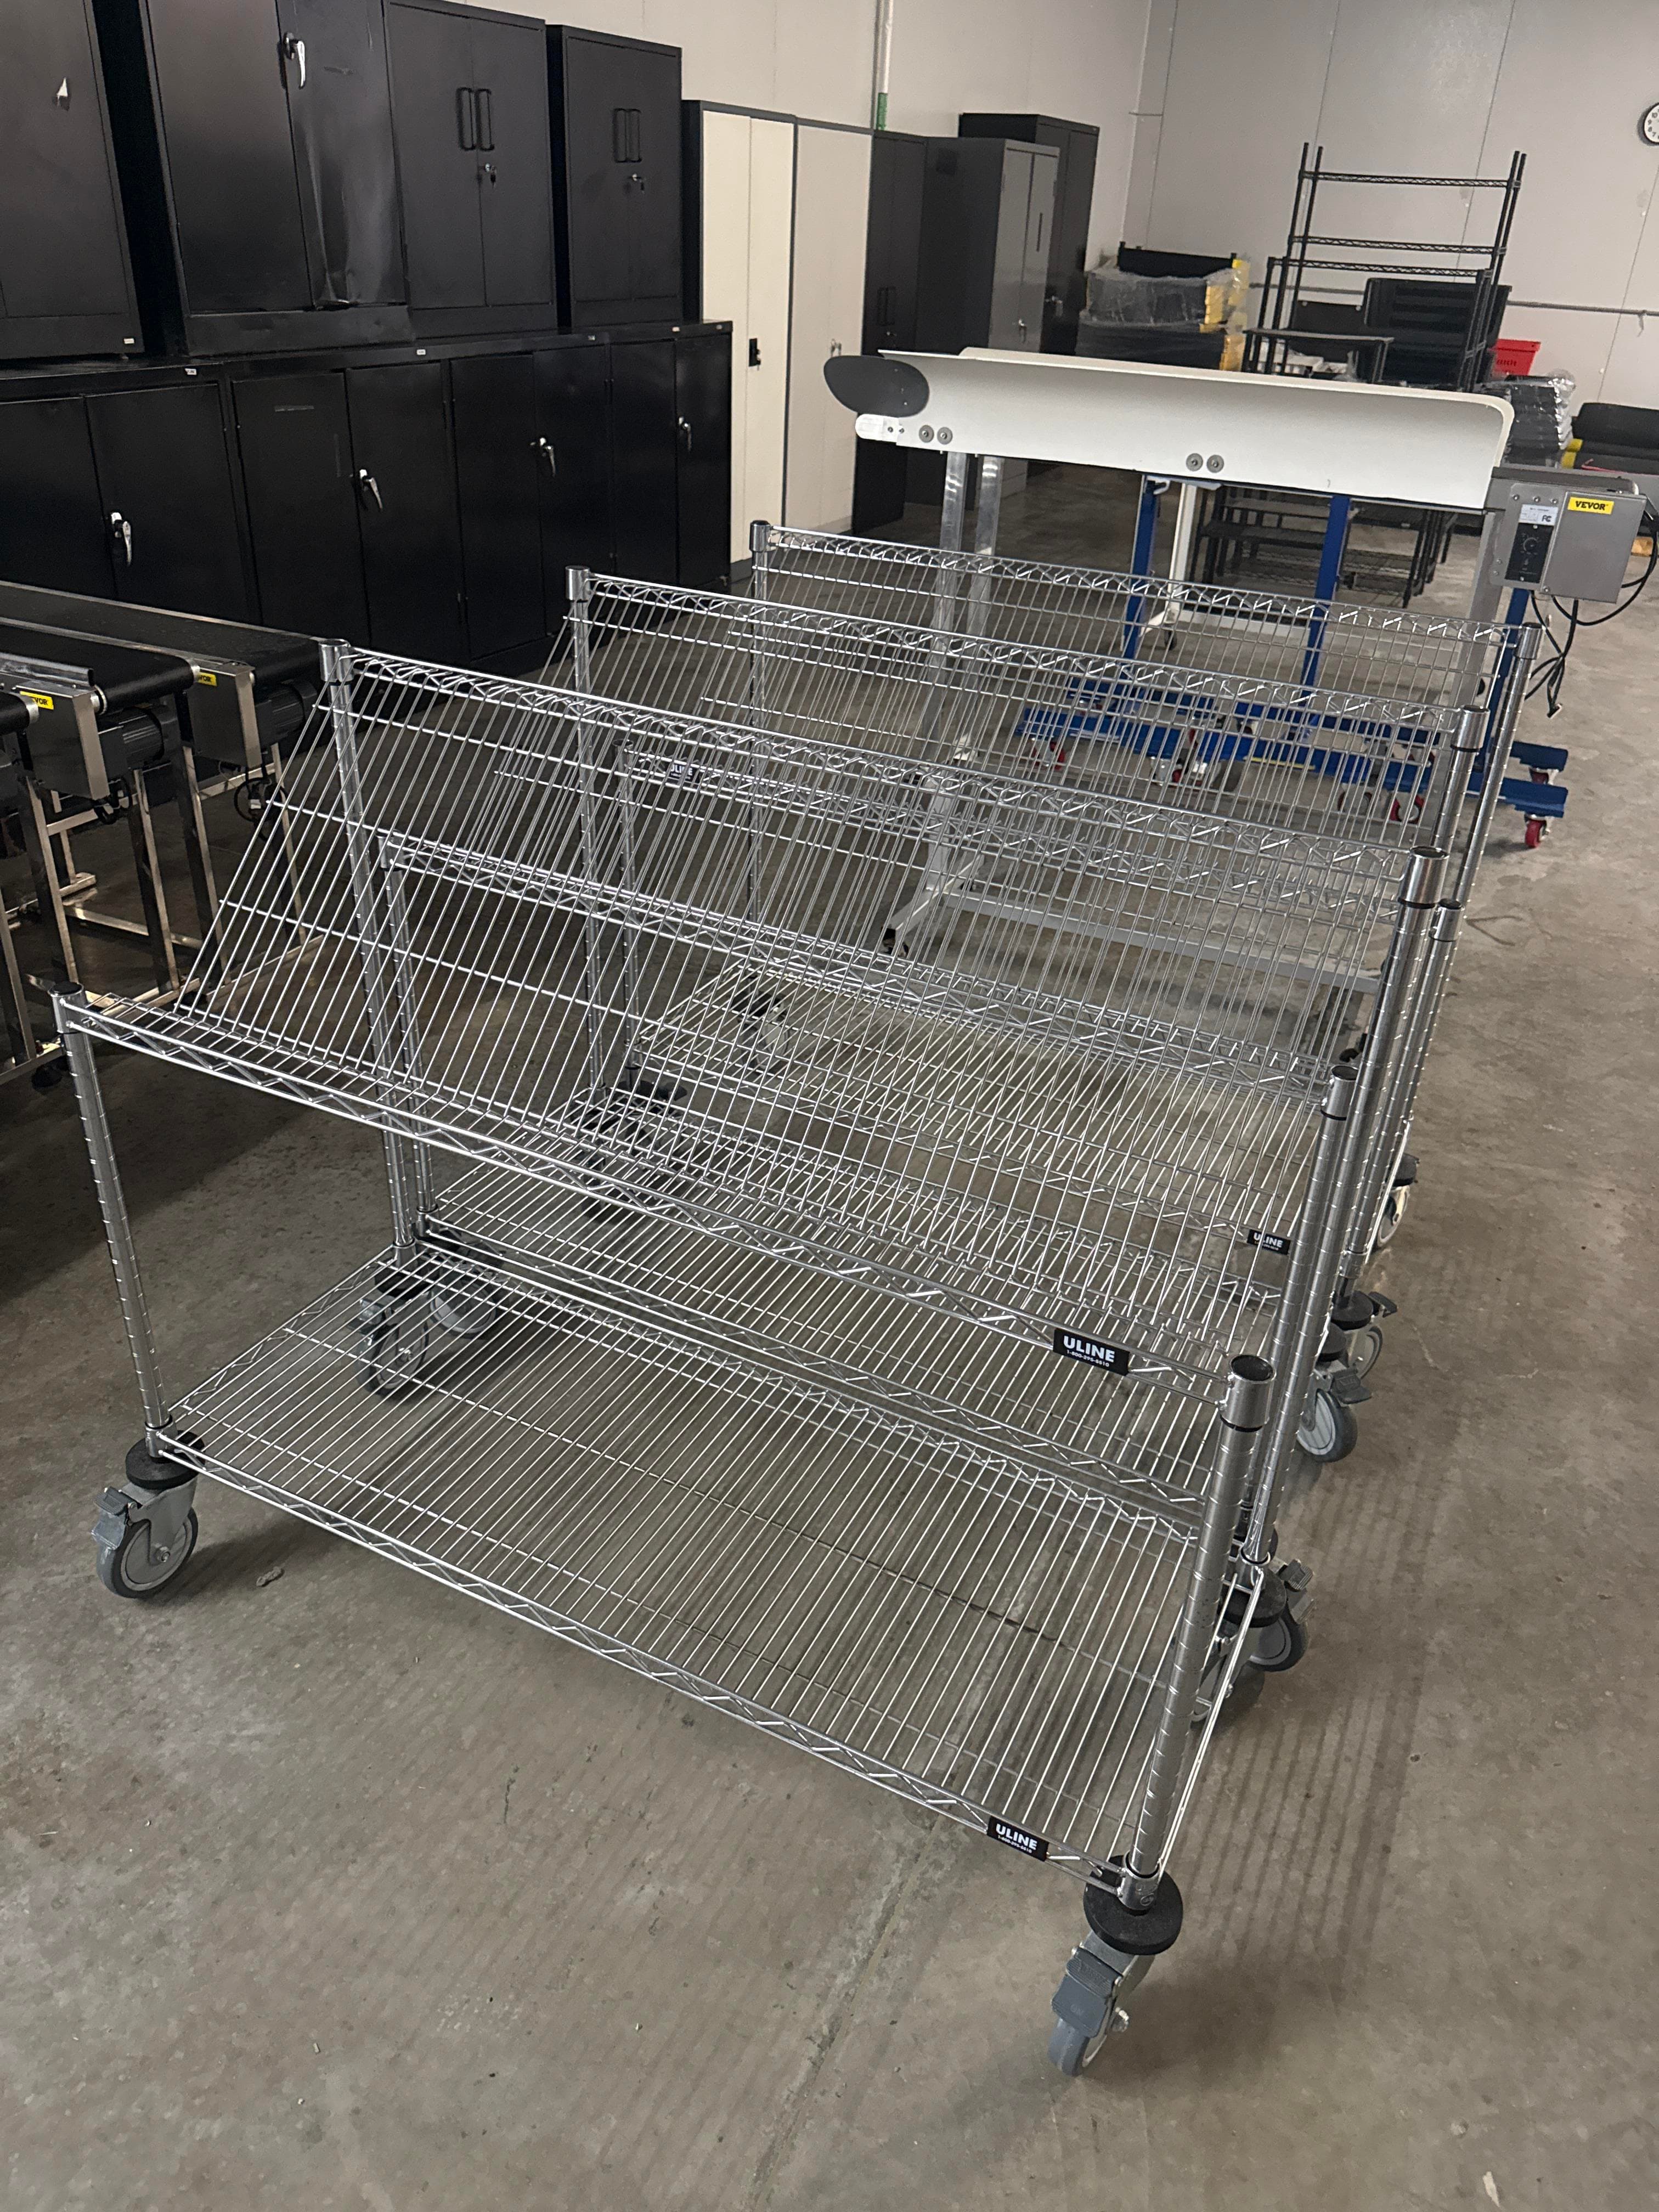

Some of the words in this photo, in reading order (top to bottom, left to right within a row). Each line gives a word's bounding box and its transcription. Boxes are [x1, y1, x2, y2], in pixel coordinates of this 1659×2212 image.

[1575, 500, 1606, 511] VEVOR
[1254, 1232, 1283, 1248] UINE
[1063, 1335, 1115, 1363] ULINE
[996, 1823, 1038, 1850] ULINE
